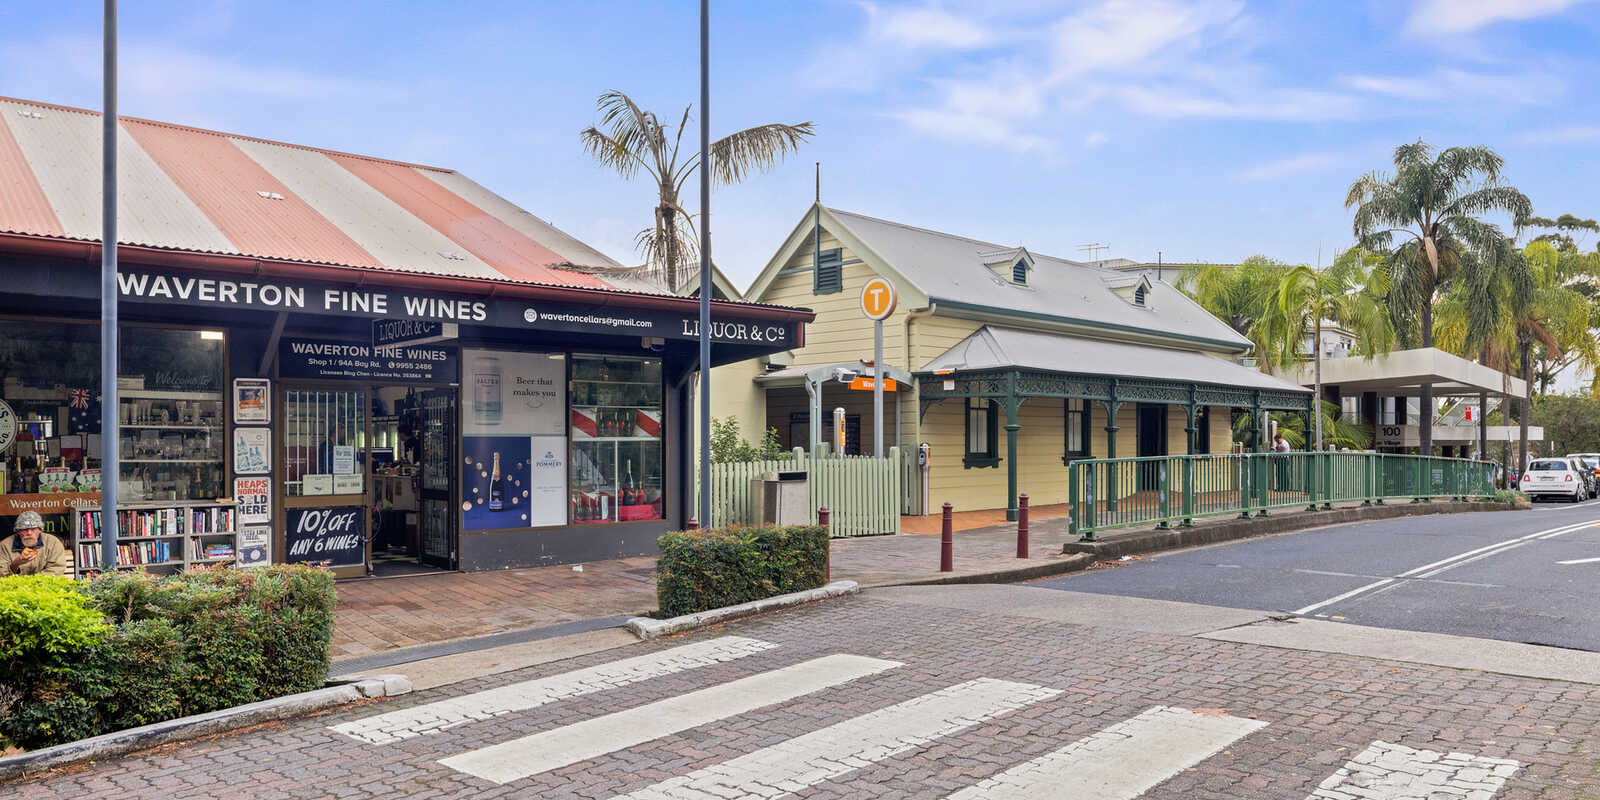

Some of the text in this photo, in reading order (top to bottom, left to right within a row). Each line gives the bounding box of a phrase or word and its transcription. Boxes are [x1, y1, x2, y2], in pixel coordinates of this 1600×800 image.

[117, 272, 487, 321] WAVERTON FINE WINES
[870, 288, 884, 311] T
[540, 312, 652, 328] wavertoncellars@gmail.com
[379, 320, 413, 341] LIQUOR
[414, 321, 422, 334] &
[750, 326, 763, 341] &
[291, 342, 447, 361] WAVERTON FINE WINES
[308, 358, 327, 367] Shop
[354, 360, 369, 368] Bay
[516, 376, 535, 385] Beer
[513, 388, 556, 399] makes you
[1382, 427, 1400, 436] 100
[237, 480, 268, 489] HEAPS
[9, 498, 98, 510] Waverton Cellars
[238, 506, 267, 515] HERE
[296, 510, 356, 537] 10% OFF
[290, 534, 359, 556] ANY 6 WINES
